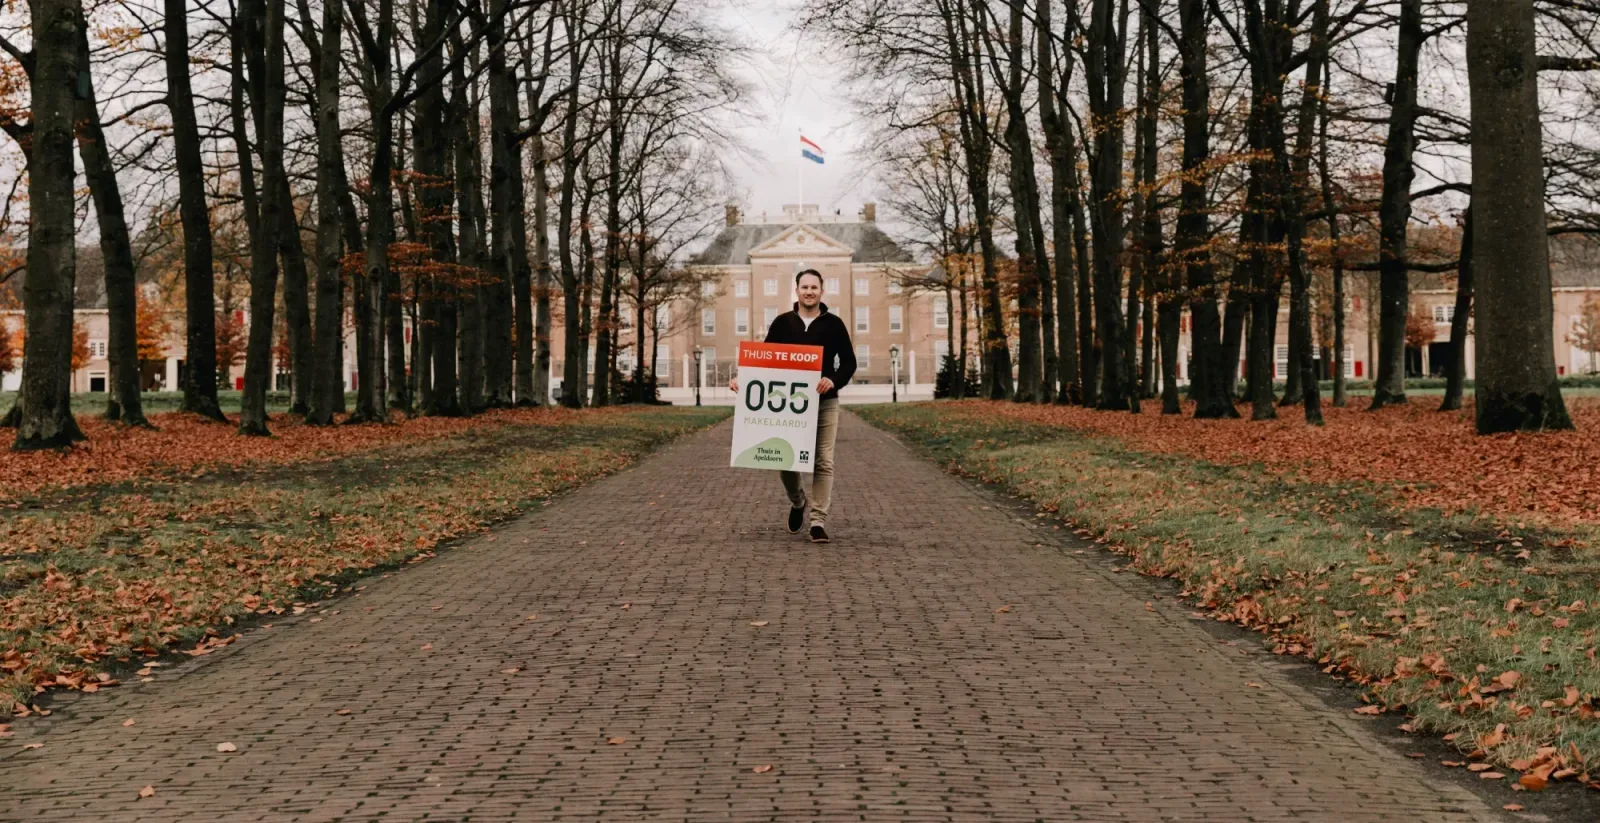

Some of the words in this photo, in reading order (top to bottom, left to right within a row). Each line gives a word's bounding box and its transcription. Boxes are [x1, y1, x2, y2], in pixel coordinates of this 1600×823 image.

[743, 349, 773, 360] THUIS
[775, 352, 788, 361] TE
[790, 352, 818, 362] KOOP
[745, 380, 809, 414] 055
